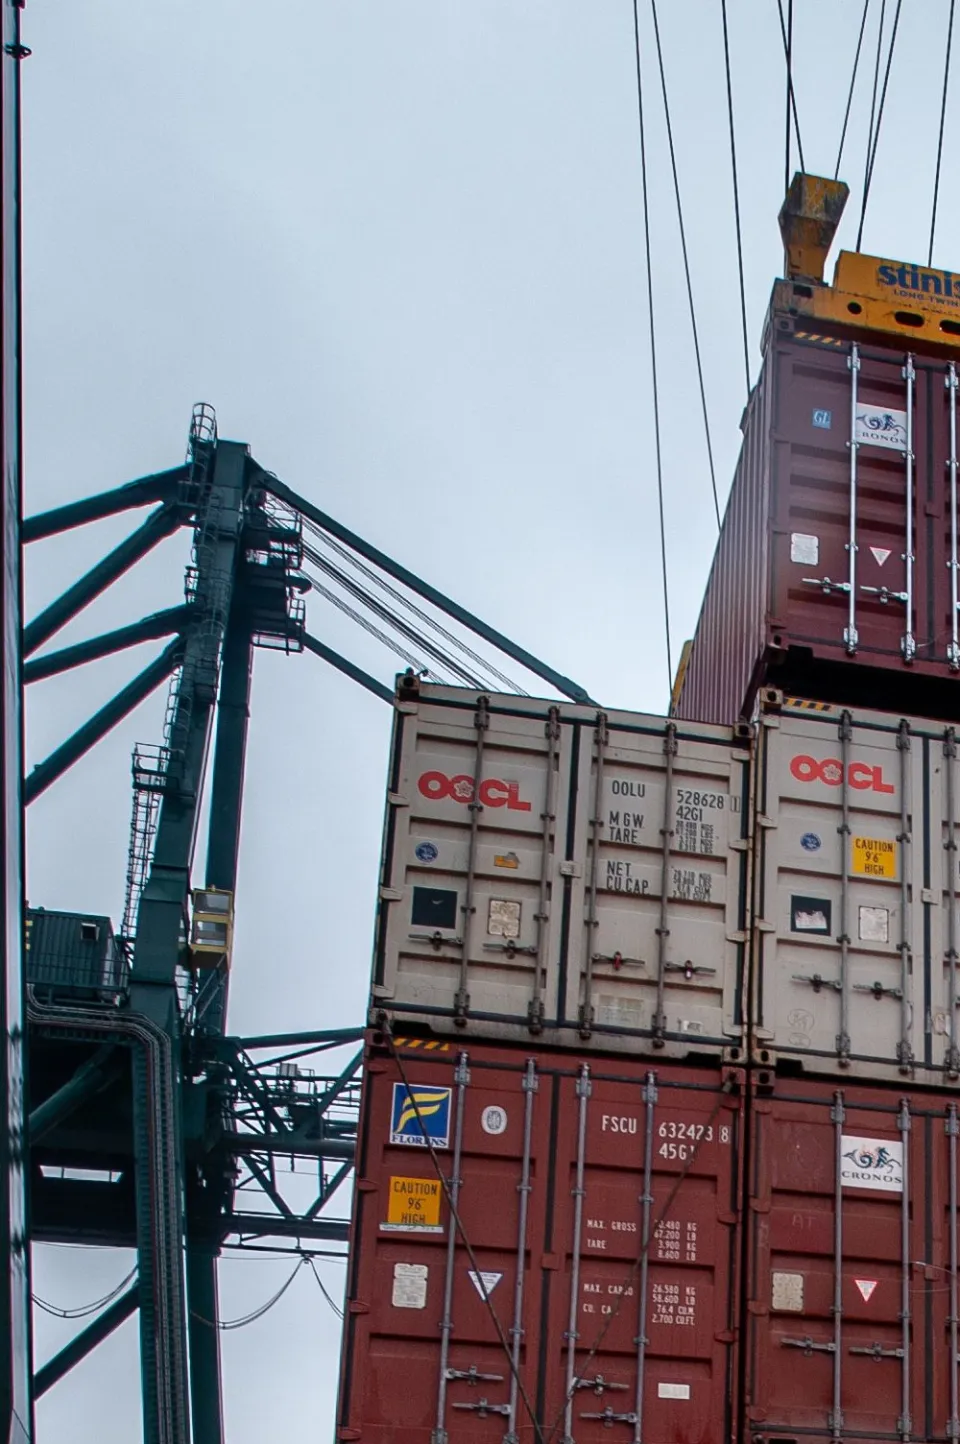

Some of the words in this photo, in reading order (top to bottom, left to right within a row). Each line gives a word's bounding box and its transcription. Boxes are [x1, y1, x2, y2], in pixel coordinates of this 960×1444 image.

[894, 289, 924, 302] LONG
[814, 411, 831, 429] GL
[790, 755, 895, 794] OOCL
[418, 771, 533, 812] OOCL
[611, 780, 646, 797] OOLU
[677, 789, 726, 809] 528628
[675, 805, 703, 822] 42G1
[855, 838, 895, 853] CAUTION
[864, 863, 884, 875] HIGH
[602, 1115, 637, 1134] FSCU
[658, 1121, 713, 1142] 632423
[719, 1126, 731, 1144] 8
[841, 1171, 903, 1184] CRONOS
[394, 1181, 437, 1196] CAUTION
[401, 1213, 426, 1224] HIGH
[587, 1219, 606, 1230] MAX.
[612, 1221, 637, 1232] GROSS
[687, 1223, 697, 1232] KG
[687, 1233, 697, 1241] LB
[587, 1239, 607, 1250] TARE
[687, 1243, 697, 1251] KG
[687, 1252, 697, 1261] LB
[653, 1284, 680, 1295] 26.580
[686, 1287, 696, 1296] KG
[686, 1296, 696, 1305] LB
[657, 1304, 673, 1314] 76.4
[652, 1315, 673, 1324] 2.700
